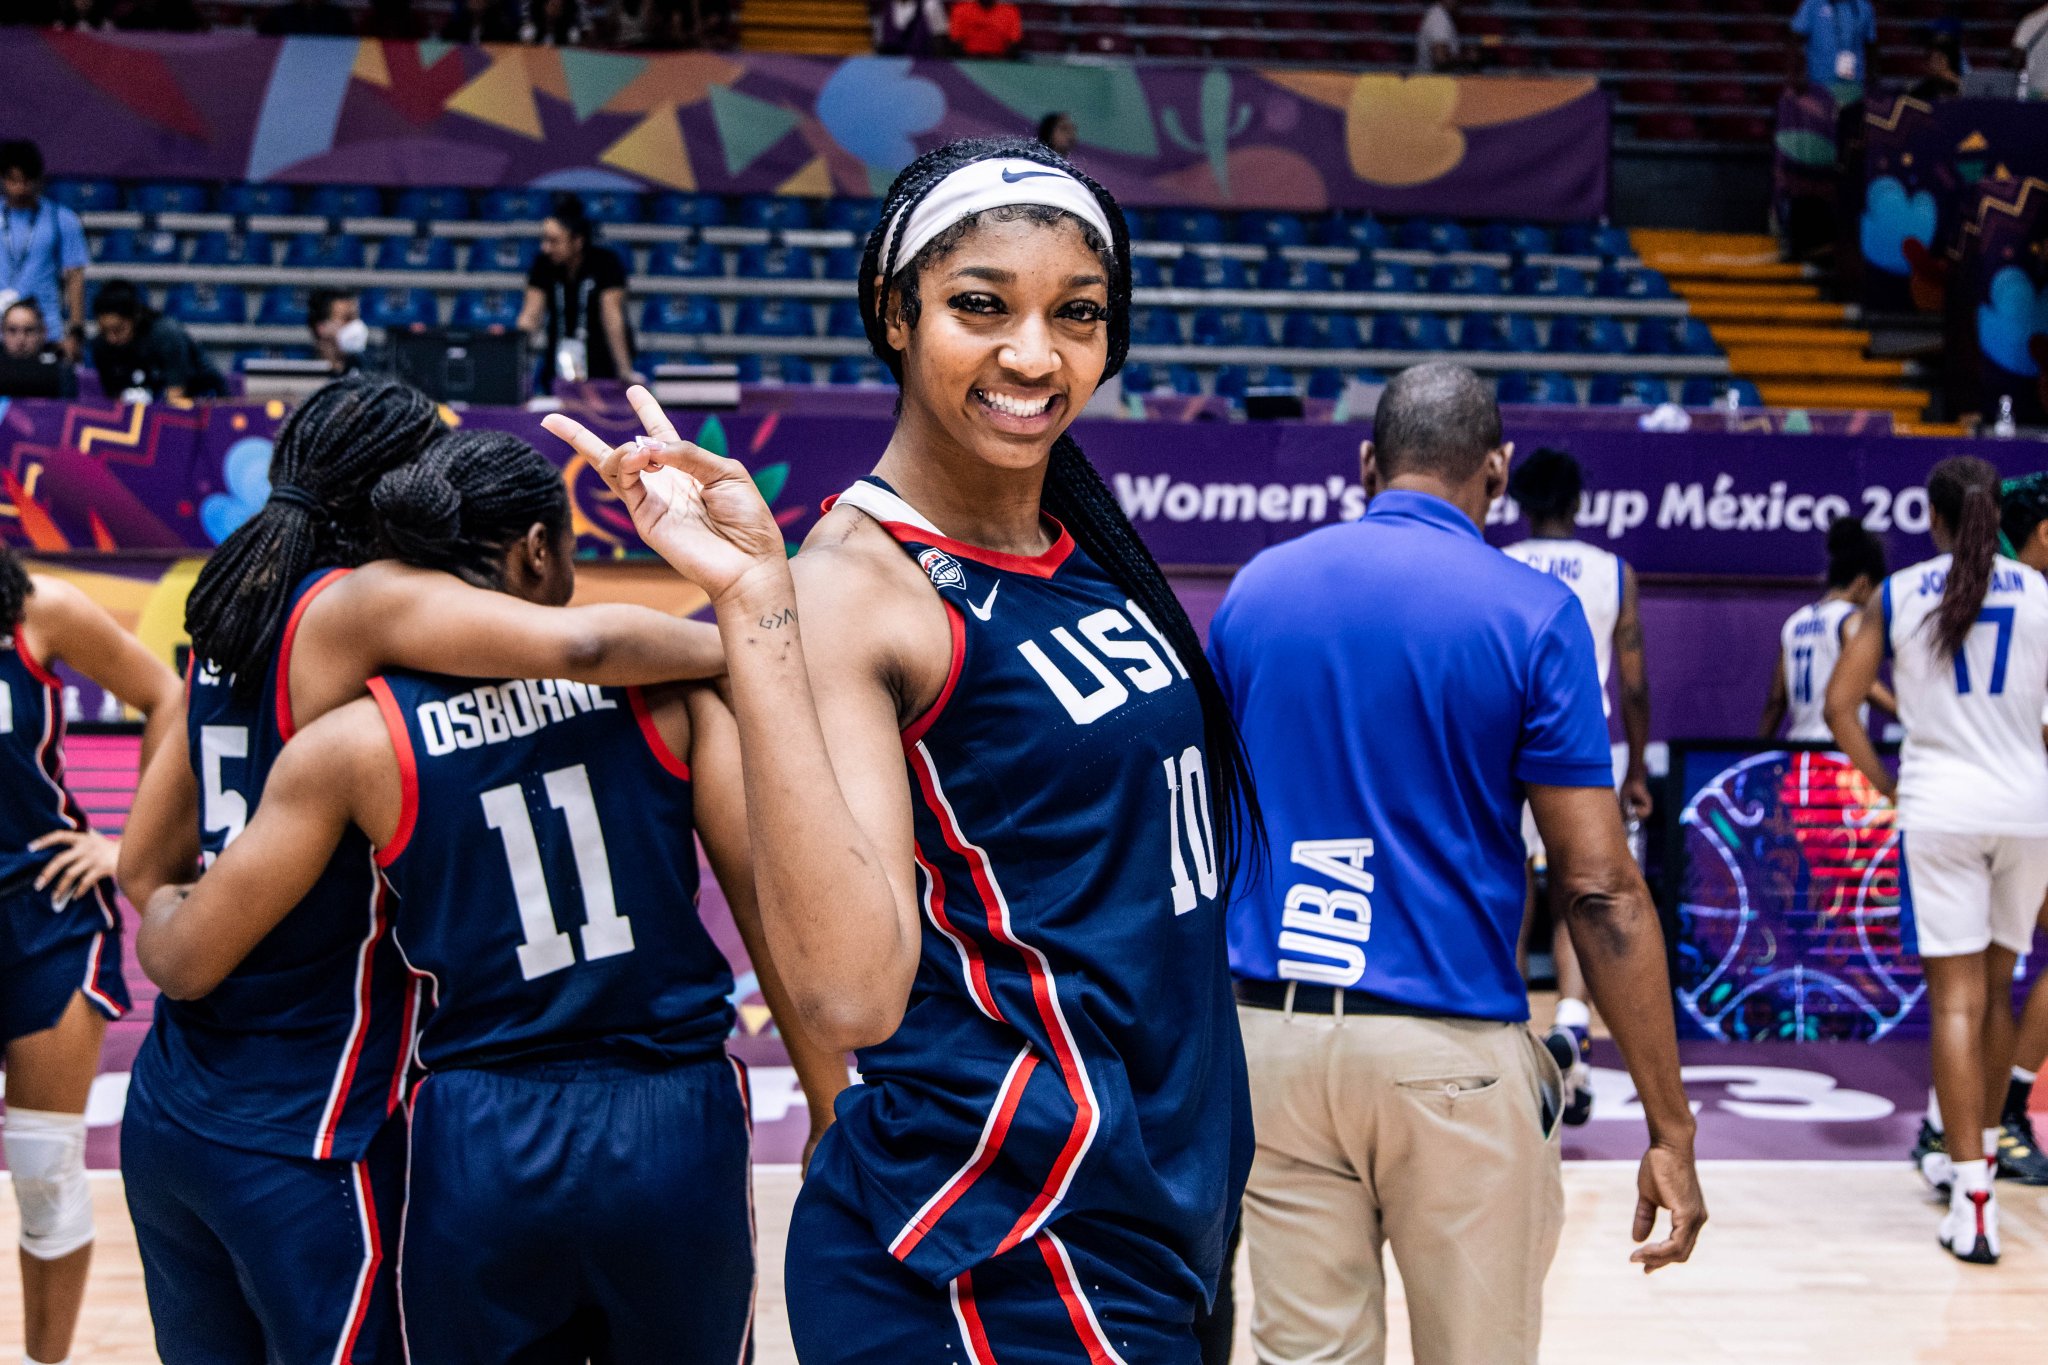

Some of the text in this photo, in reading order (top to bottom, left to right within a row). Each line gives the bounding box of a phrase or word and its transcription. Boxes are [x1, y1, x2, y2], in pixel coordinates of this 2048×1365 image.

[1114, 473, 1366, 522] Women's
[1656, 472, 1850, 532] México
[1861, 485, 1932, 534] 20
[480, 763, 635, 981] 11
[1163, 745, 1218, 916] 10
[1277, 837, 1375, 987] UBA
